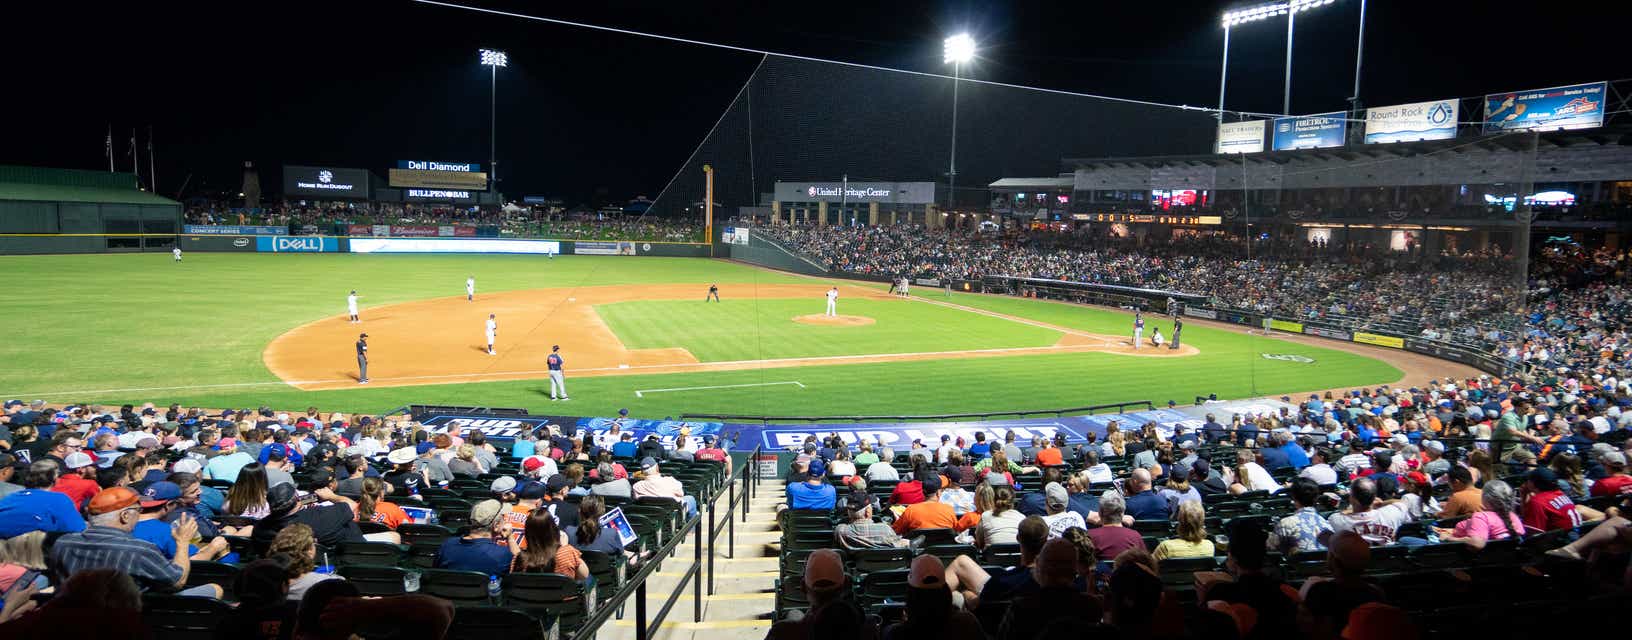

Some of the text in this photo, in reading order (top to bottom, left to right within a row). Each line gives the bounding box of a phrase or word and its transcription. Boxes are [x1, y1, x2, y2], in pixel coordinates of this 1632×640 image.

[1370, 106, 1424, 120] Round Rock
[408, 161, 470, 172] Dell Diamond
[409, 190, 446, 198] BULLPEN
[816, 188, 838, 196] United
[867, 188, 890, 197] Center
[279, 238, 319, 250] DELL
[775, 429, 900, 447] BUD
